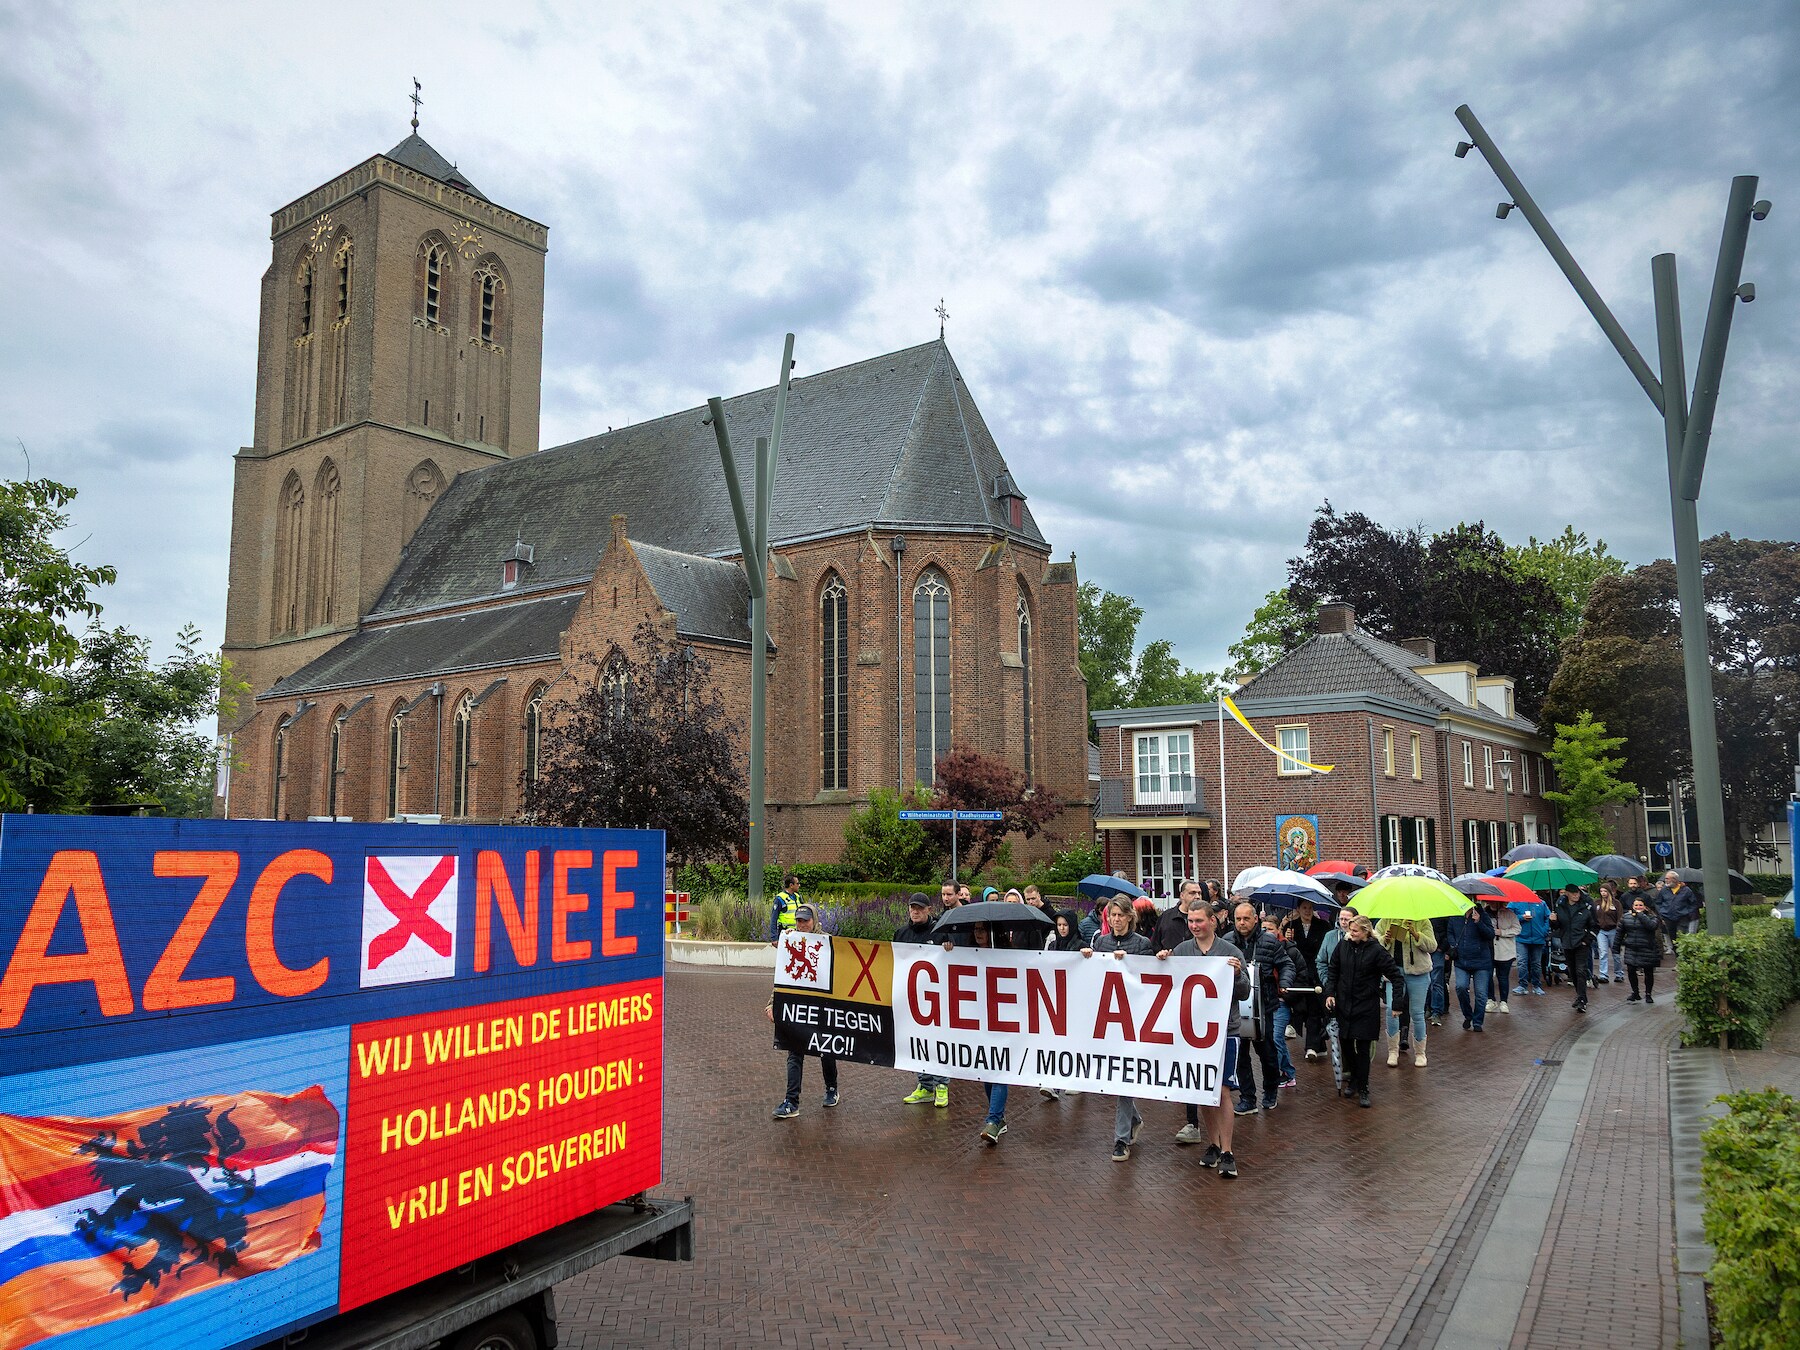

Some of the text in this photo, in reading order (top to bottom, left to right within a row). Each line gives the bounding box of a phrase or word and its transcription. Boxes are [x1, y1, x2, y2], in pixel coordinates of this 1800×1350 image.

[0, 849, 639, 1029] AZC NEE
[357, 993, 653, 1078] WIJ WILLEN DE LIEMERS
[782, 1003, 882, 1034] NEE TEGEN
[907, 960, 1220, 1049] GEEN AZC
[808, 1032, 855, 1056] AZC!!
[910, 1036, 930, 1062] IN
[936, 1040, 1010, 1072] DIDAM
[1036, 1049, 1218, 1092] MONTFERLAND
[380, 1082, 531, 1154] HOLLANDS
[385, 1120, 627, 1230] VRIJ EN SOEVEREIN
